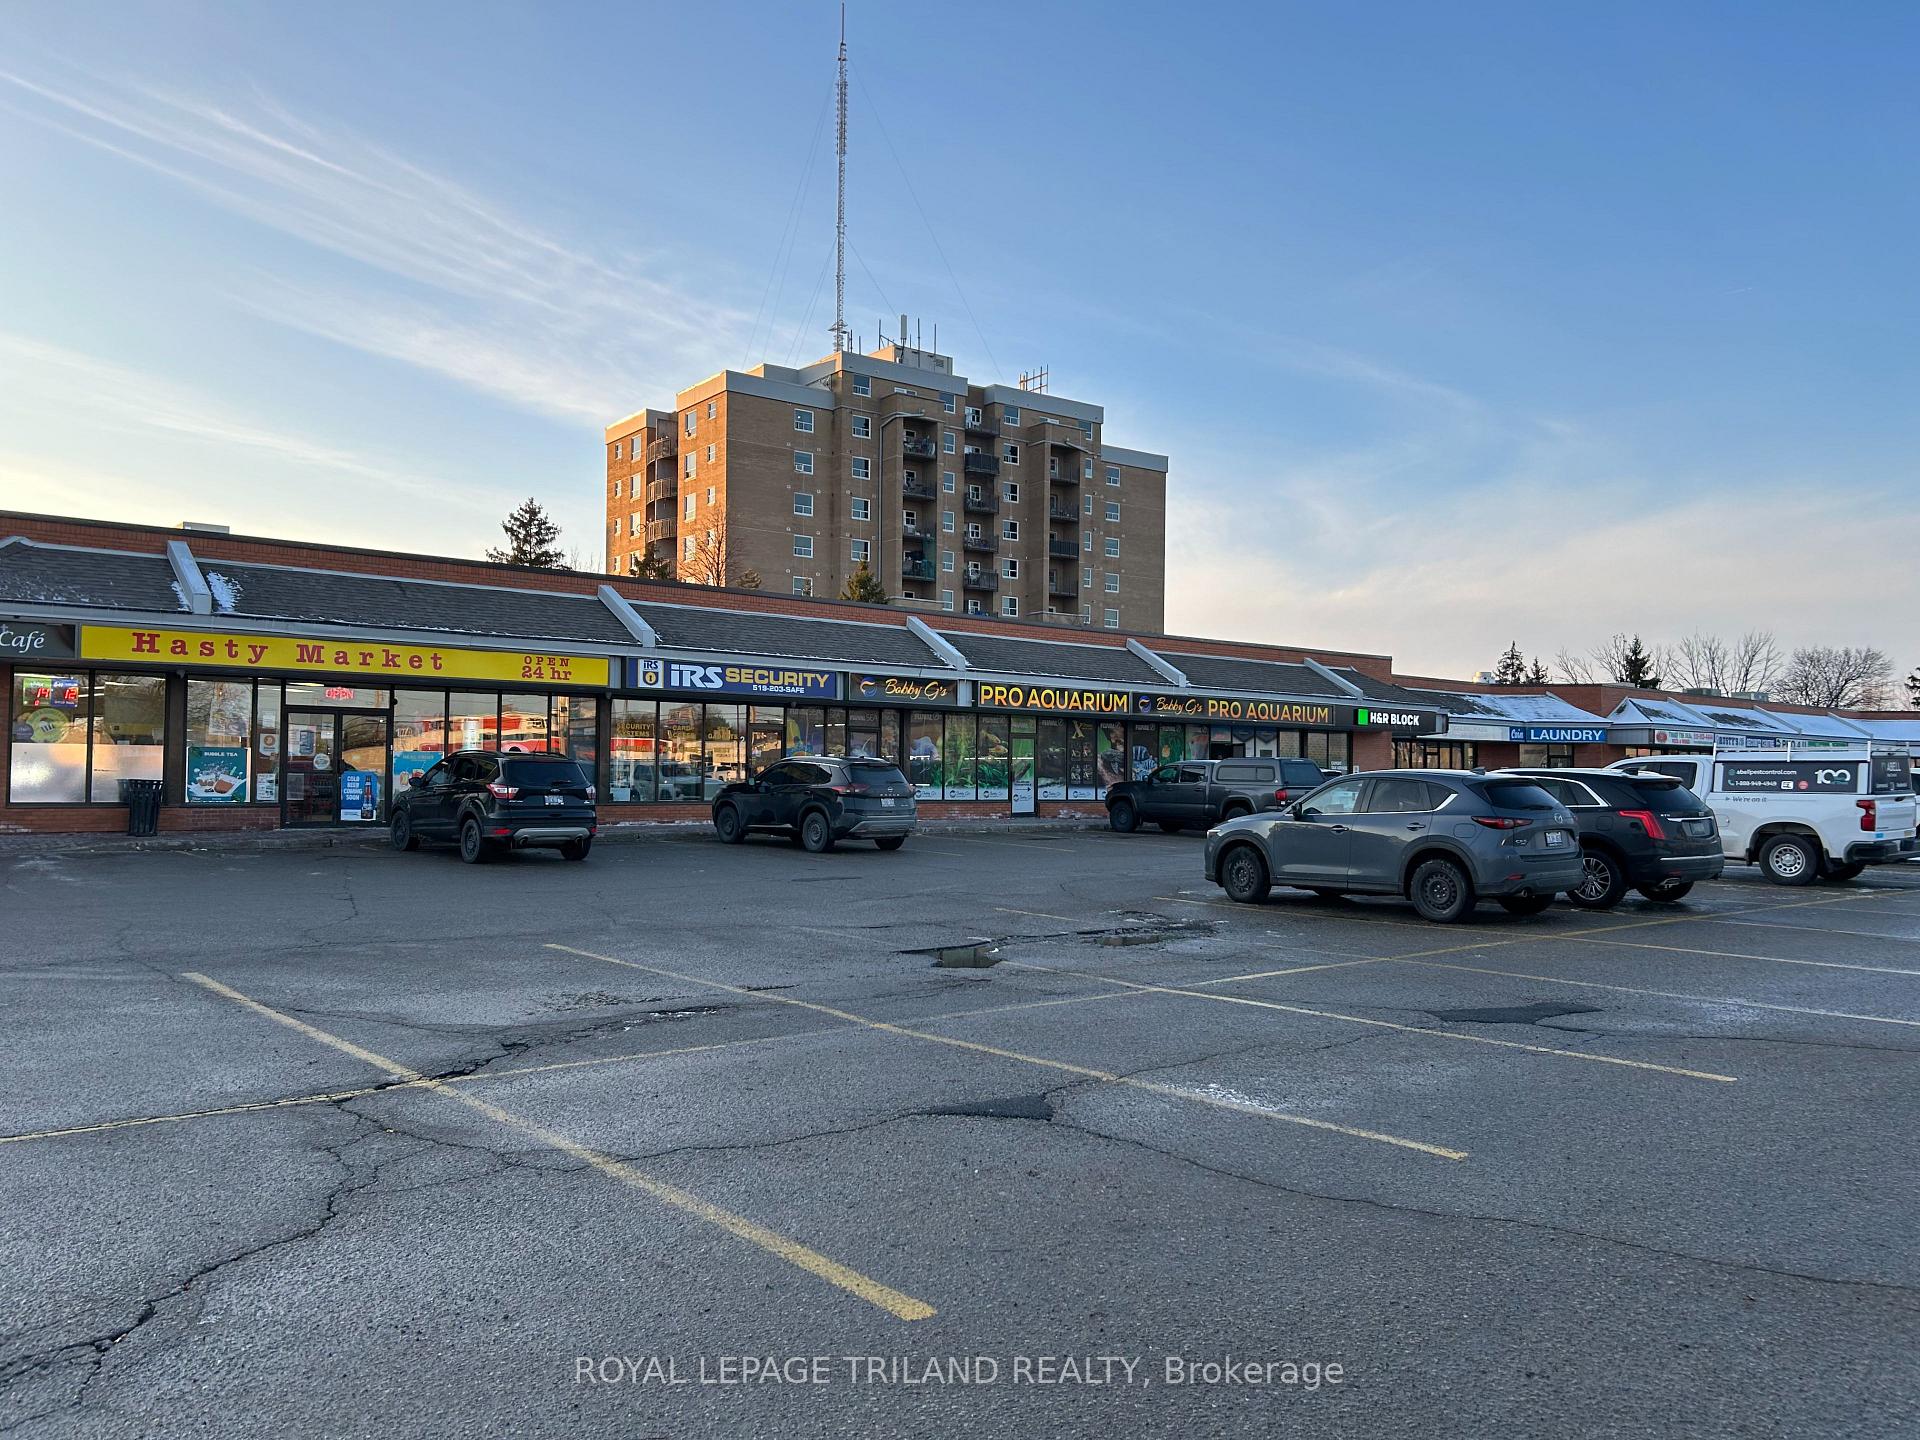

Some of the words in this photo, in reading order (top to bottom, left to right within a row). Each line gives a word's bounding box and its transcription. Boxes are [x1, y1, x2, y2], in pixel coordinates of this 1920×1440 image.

[0, 631, 46, 654] Café
[131, 632, 269, 664] Hasty
[295, 643, 444, 671] Market
[523, 655, 571, 667] OPEN
[521, 665, 544, 680] 24
[549, 667, 573, 681] hr
[725, 667, 830, 688] SECURITY
[36, 687, 50, 698] 14
[64, 687, 77, 700] 12
[325, 688, 355, 699] OPEN
[924, 681, 948, 701] G's
[980, 685, 1023, 707] PRO
[1026, 690, 1128, 713] AQUARIUM
[1208, 699, 1241, 719] PRO
[1245, 702, 1329, 723] AQUARIUM
[1370, 712, 1389, 726] H&R
[1390, 713, 1420, 727] BLOCK
[1530, 729, 1603, 741] LAUNDRY
[1814, 769, 1852, 785] 100
